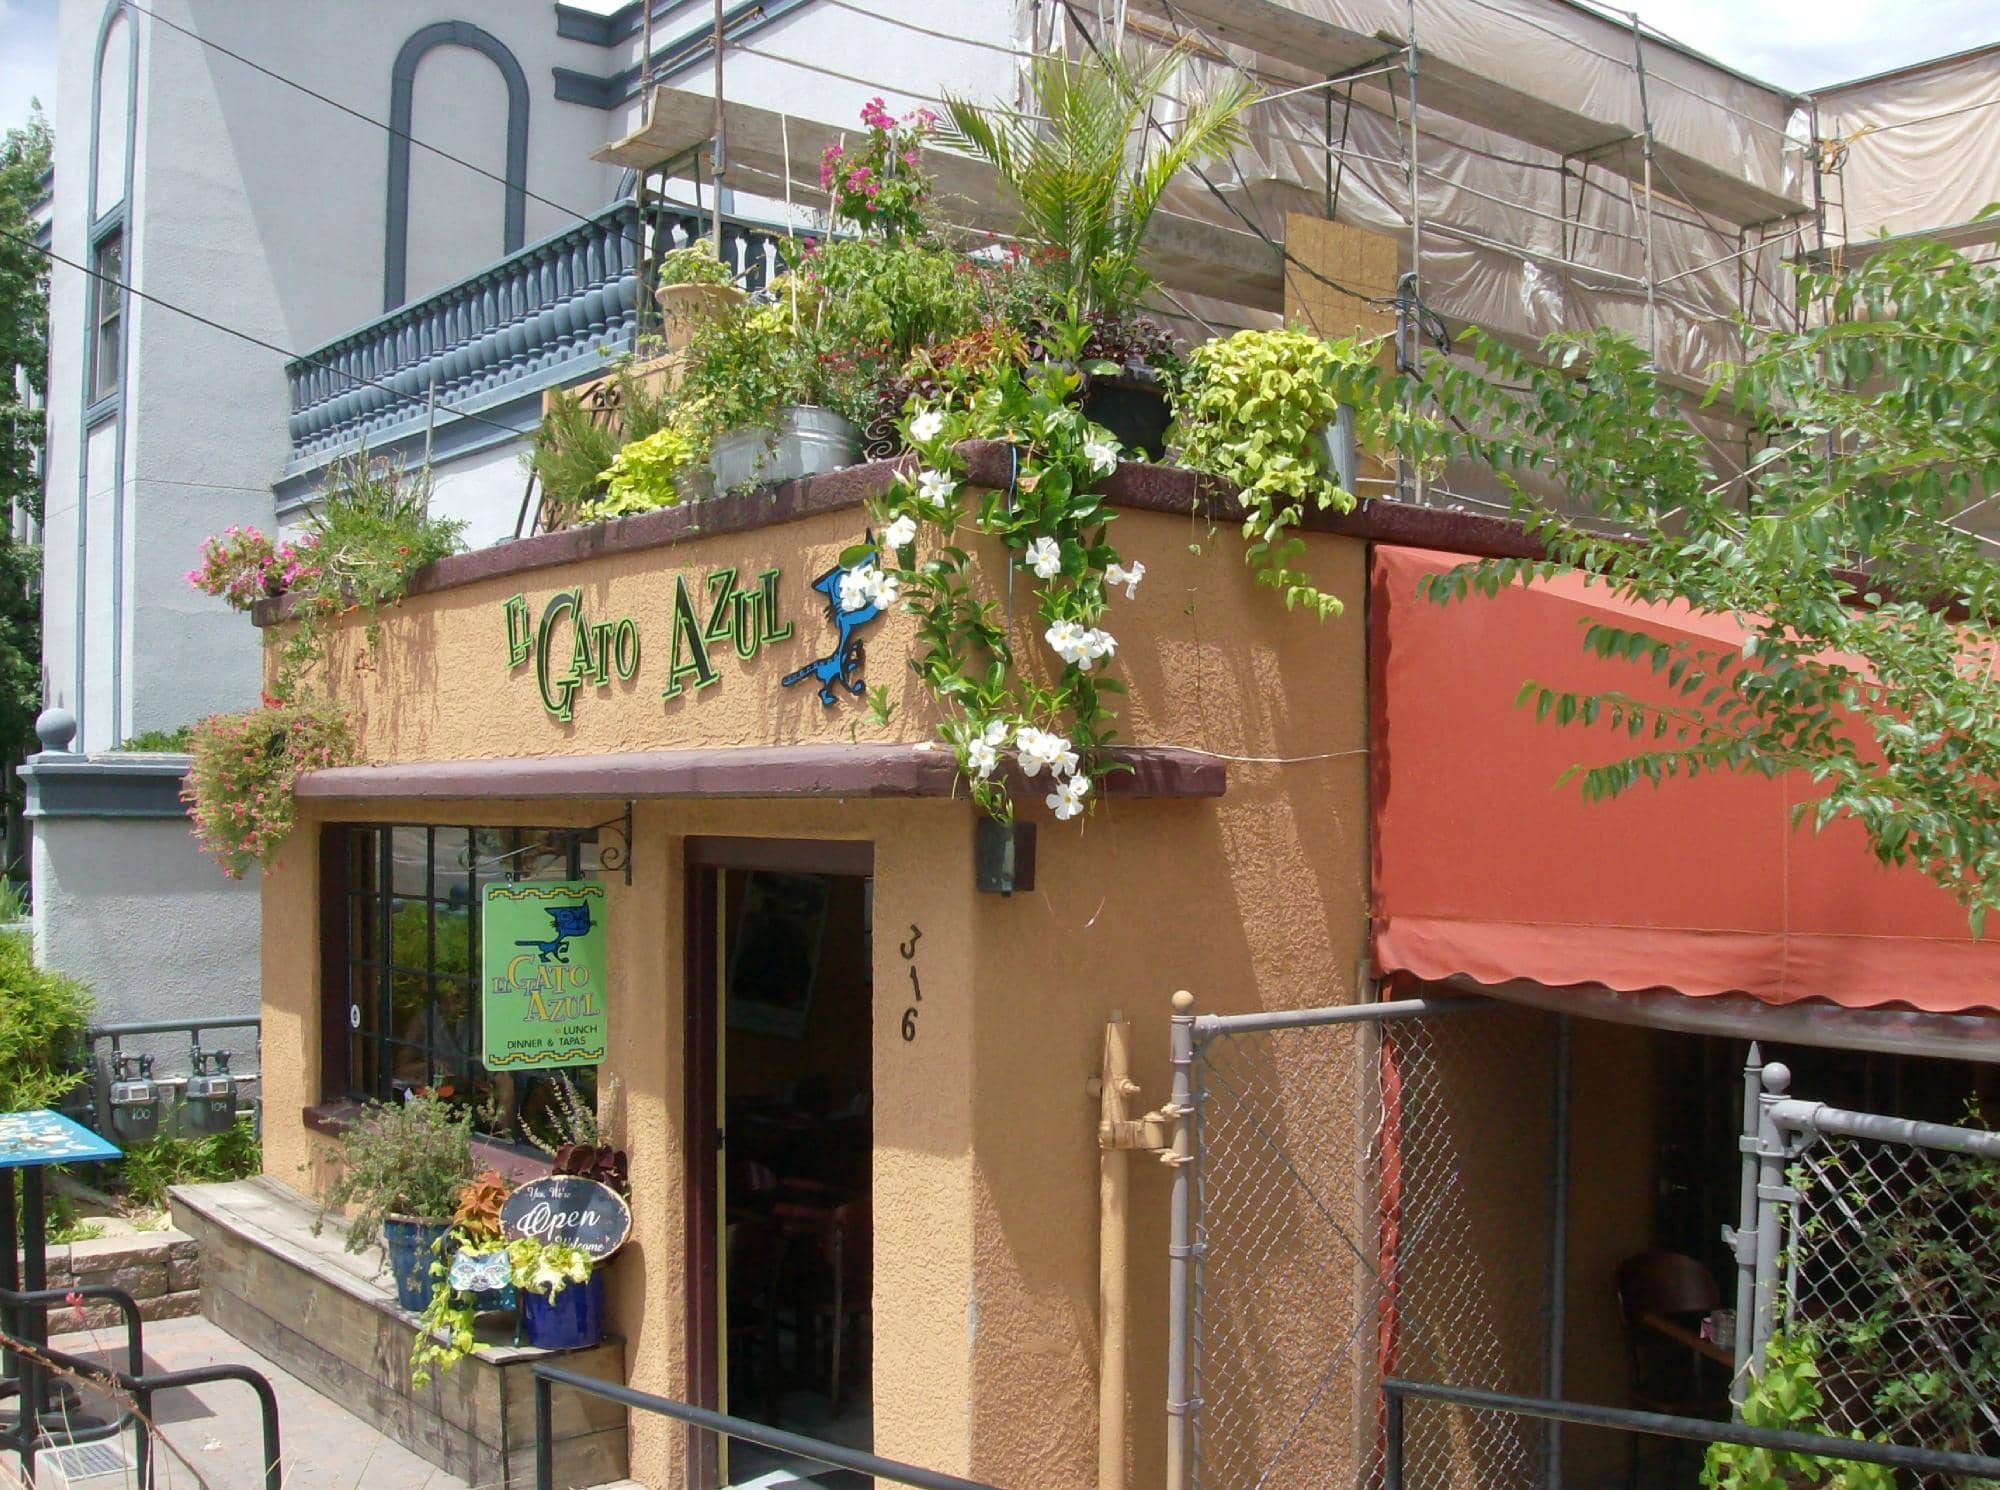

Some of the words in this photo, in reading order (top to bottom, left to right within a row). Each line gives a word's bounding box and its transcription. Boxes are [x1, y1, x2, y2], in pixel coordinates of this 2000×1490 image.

[537, 585, 640, 722] GATO
[661, 566, 793, 700] AZUL
[508, 953, 590, 997] GATO
[899, 924, 922, 1042] 316
[523, 991, 601, 1022] AZUL
[507, 1039, 543, 1049] DINNER
[547, 1038, 554, 1047] &
[559, 1036, 586, 1046] TAPAS
[563, 1024, 598, 1035] LUNCH
[132, 1108, 151, 1120] 100
[516, 1201, 601, 1241] Open
